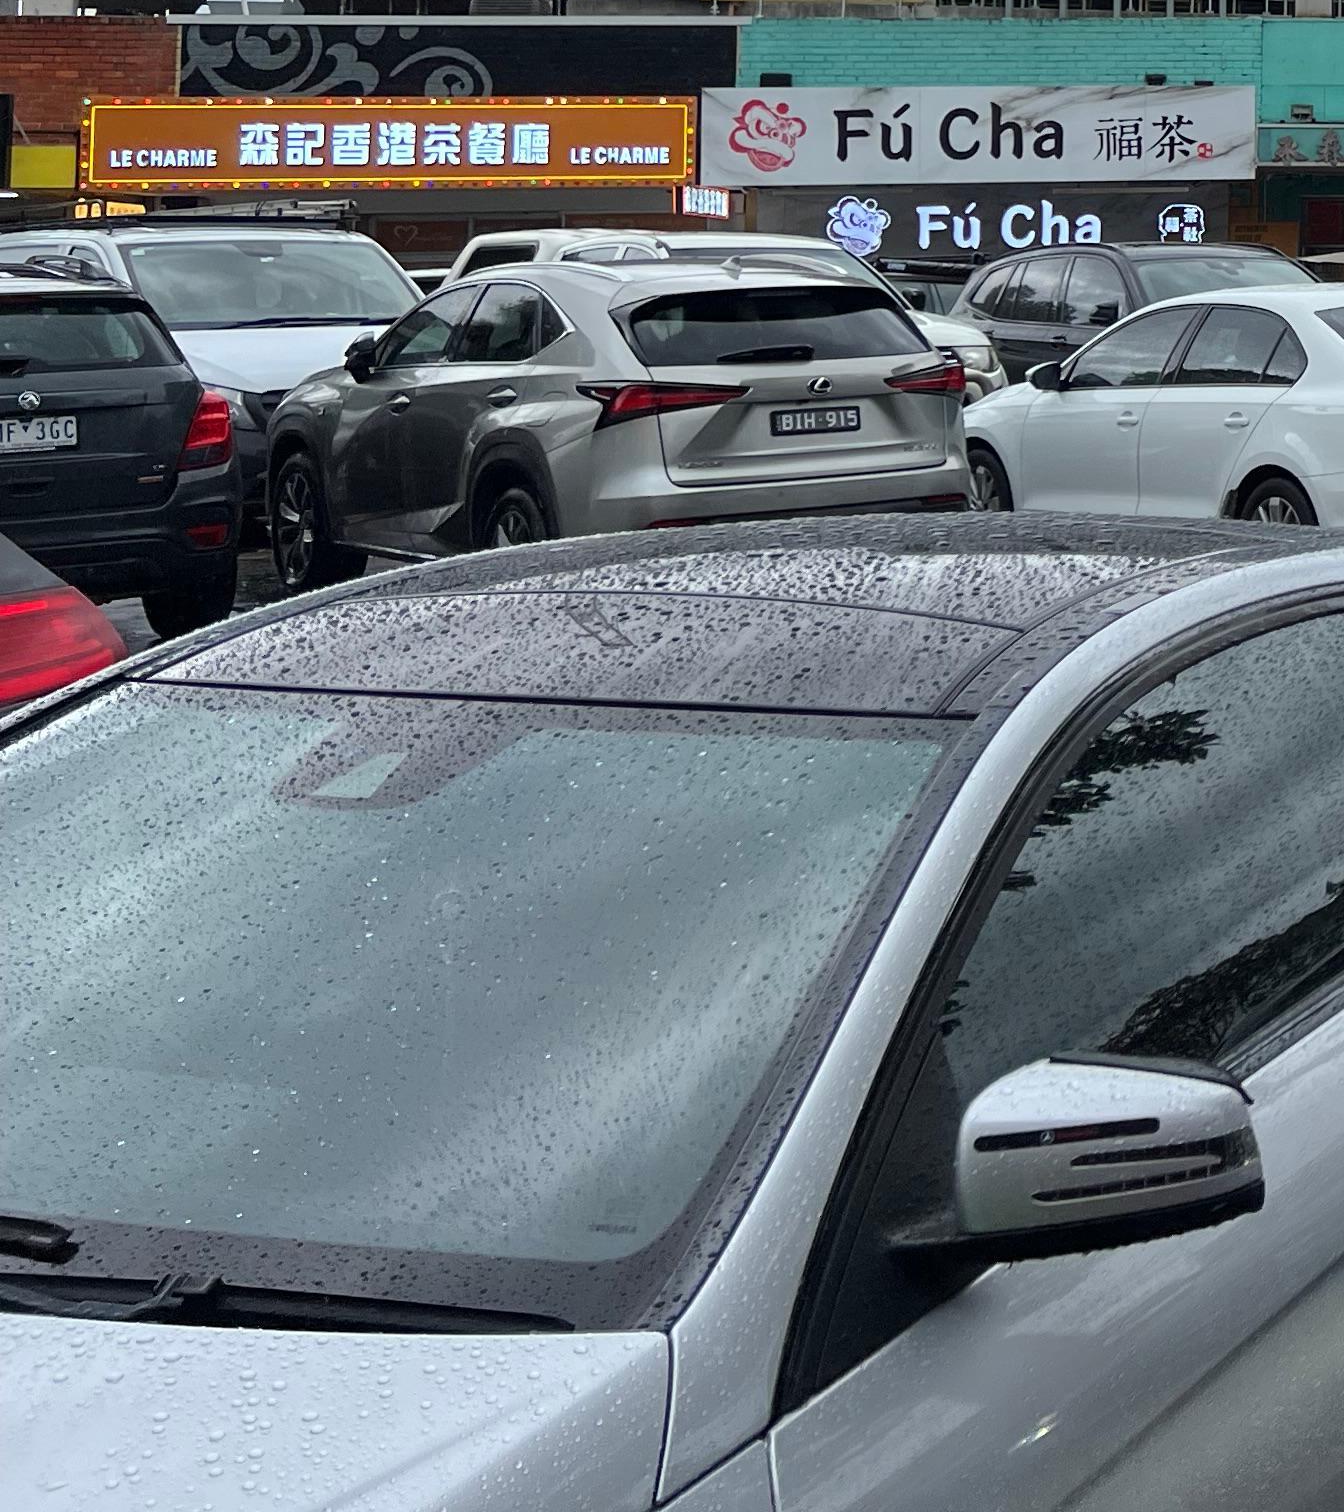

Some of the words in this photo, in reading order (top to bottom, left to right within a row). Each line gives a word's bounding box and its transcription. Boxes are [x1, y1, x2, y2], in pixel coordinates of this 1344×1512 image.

[239, 121, 551, 167] 森記香港茶餐廳
[833, 102, 914, 162] Fú
[938, 102, 1065, 161] Cha
[1092, 114, 1200, 163] 福茶
[109, 149, 133, 168] LE
[135, 148, 218, 168] CHARME
[569, 146, 591, 165] LE
[593, 146, 671, 165] CHARME
[915, 199, 982, 250] Fú
[1000, 199, 1102, 246] Cha
[36, 419, 75, 440] 3GC
[782, 411, 817, 432] BIH
[825, 409, 858, 428] 915
